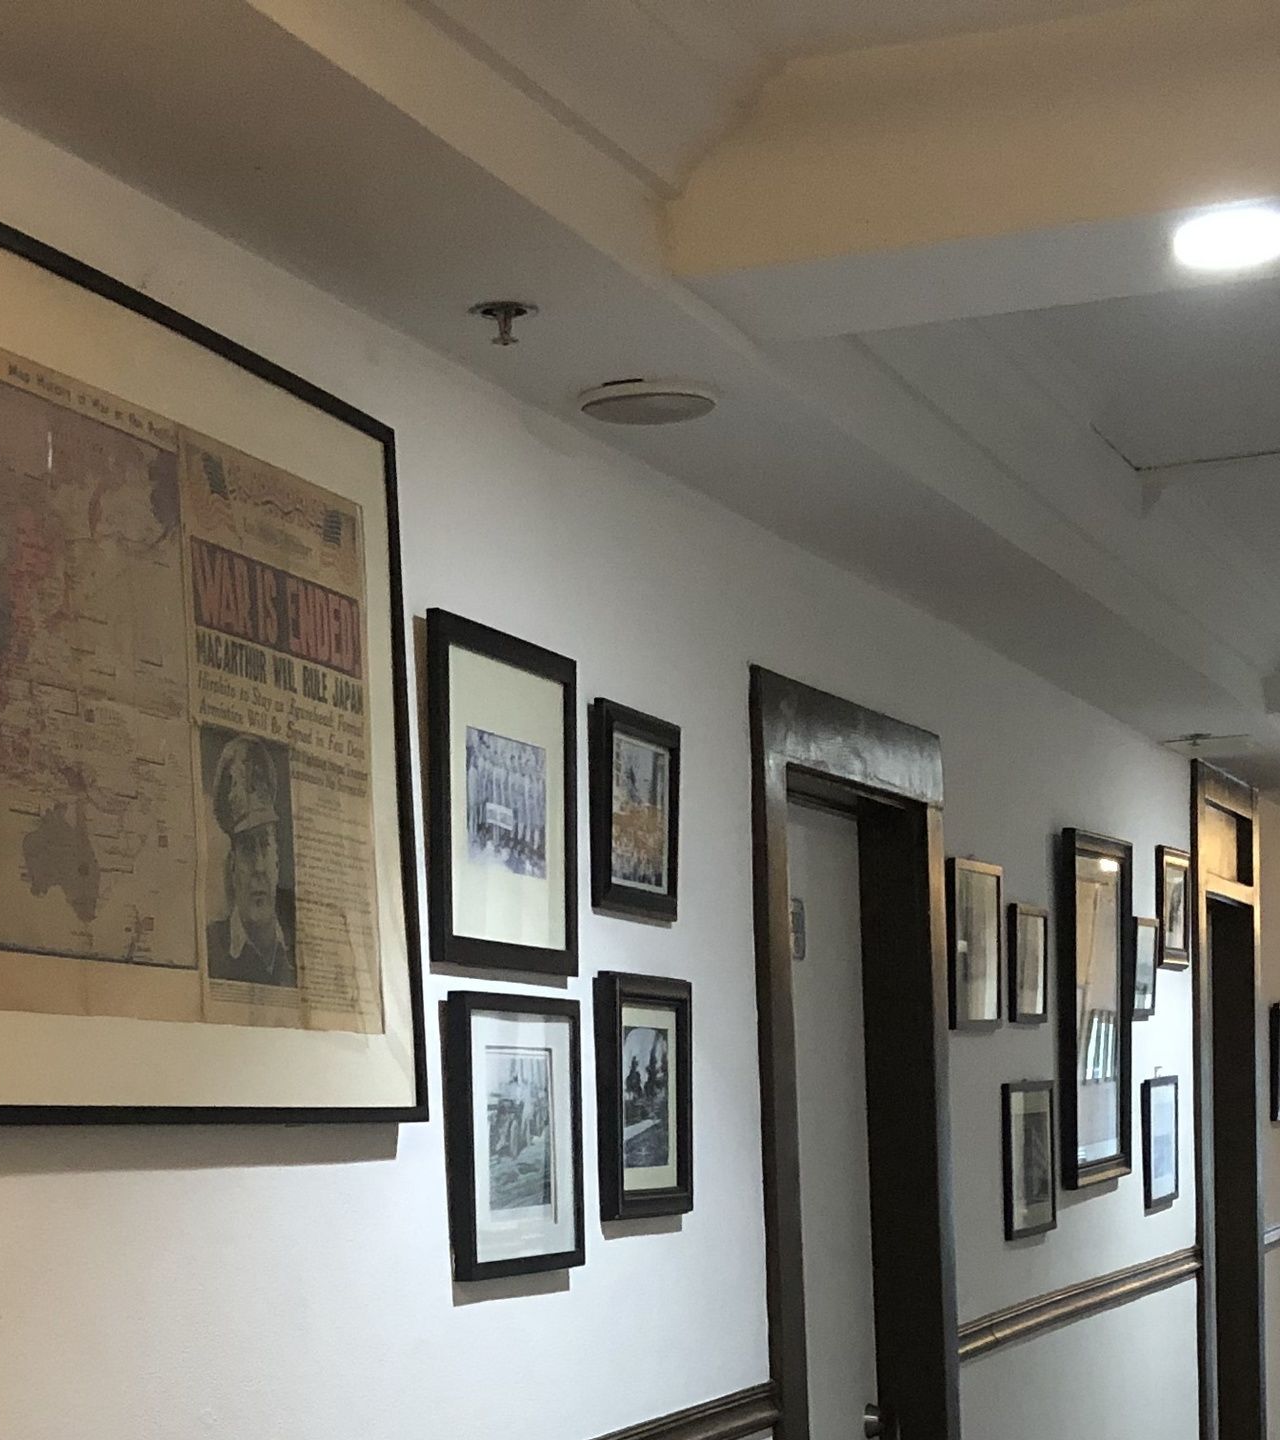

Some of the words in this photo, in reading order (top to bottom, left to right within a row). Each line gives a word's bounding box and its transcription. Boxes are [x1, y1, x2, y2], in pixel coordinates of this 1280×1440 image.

[192, 538, 250, 641] WAR
[255, 563, 278, 646] IS
[332, 676, 364, 716] JAPAN
